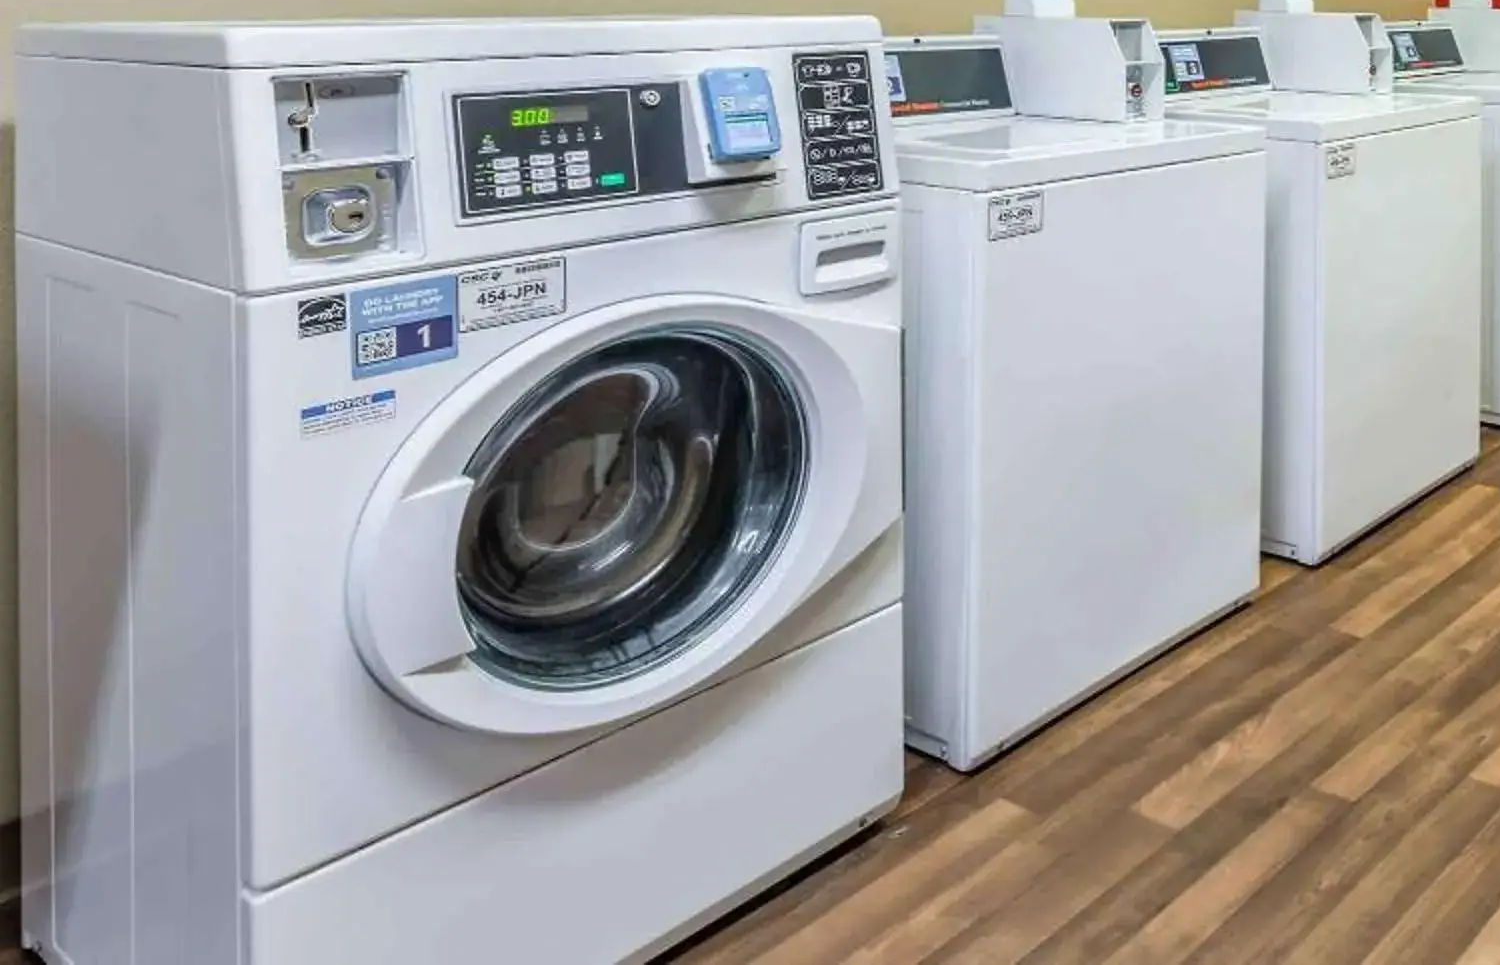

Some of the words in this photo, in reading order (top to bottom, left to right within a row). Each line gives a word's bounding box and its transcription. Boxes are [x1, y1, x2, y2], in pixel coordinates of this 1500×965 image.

[363, 296, 383, 308] DO
[384, 287, 439, 304] LAUNDRY
[476, 281, 547, 306] 454-JPN
[362, 303, 394, 316] WITH
[420, 294, 444, 307] APP
[416, 324, 431, 348] 1
[325, 394, 371, 414] NOTICE
